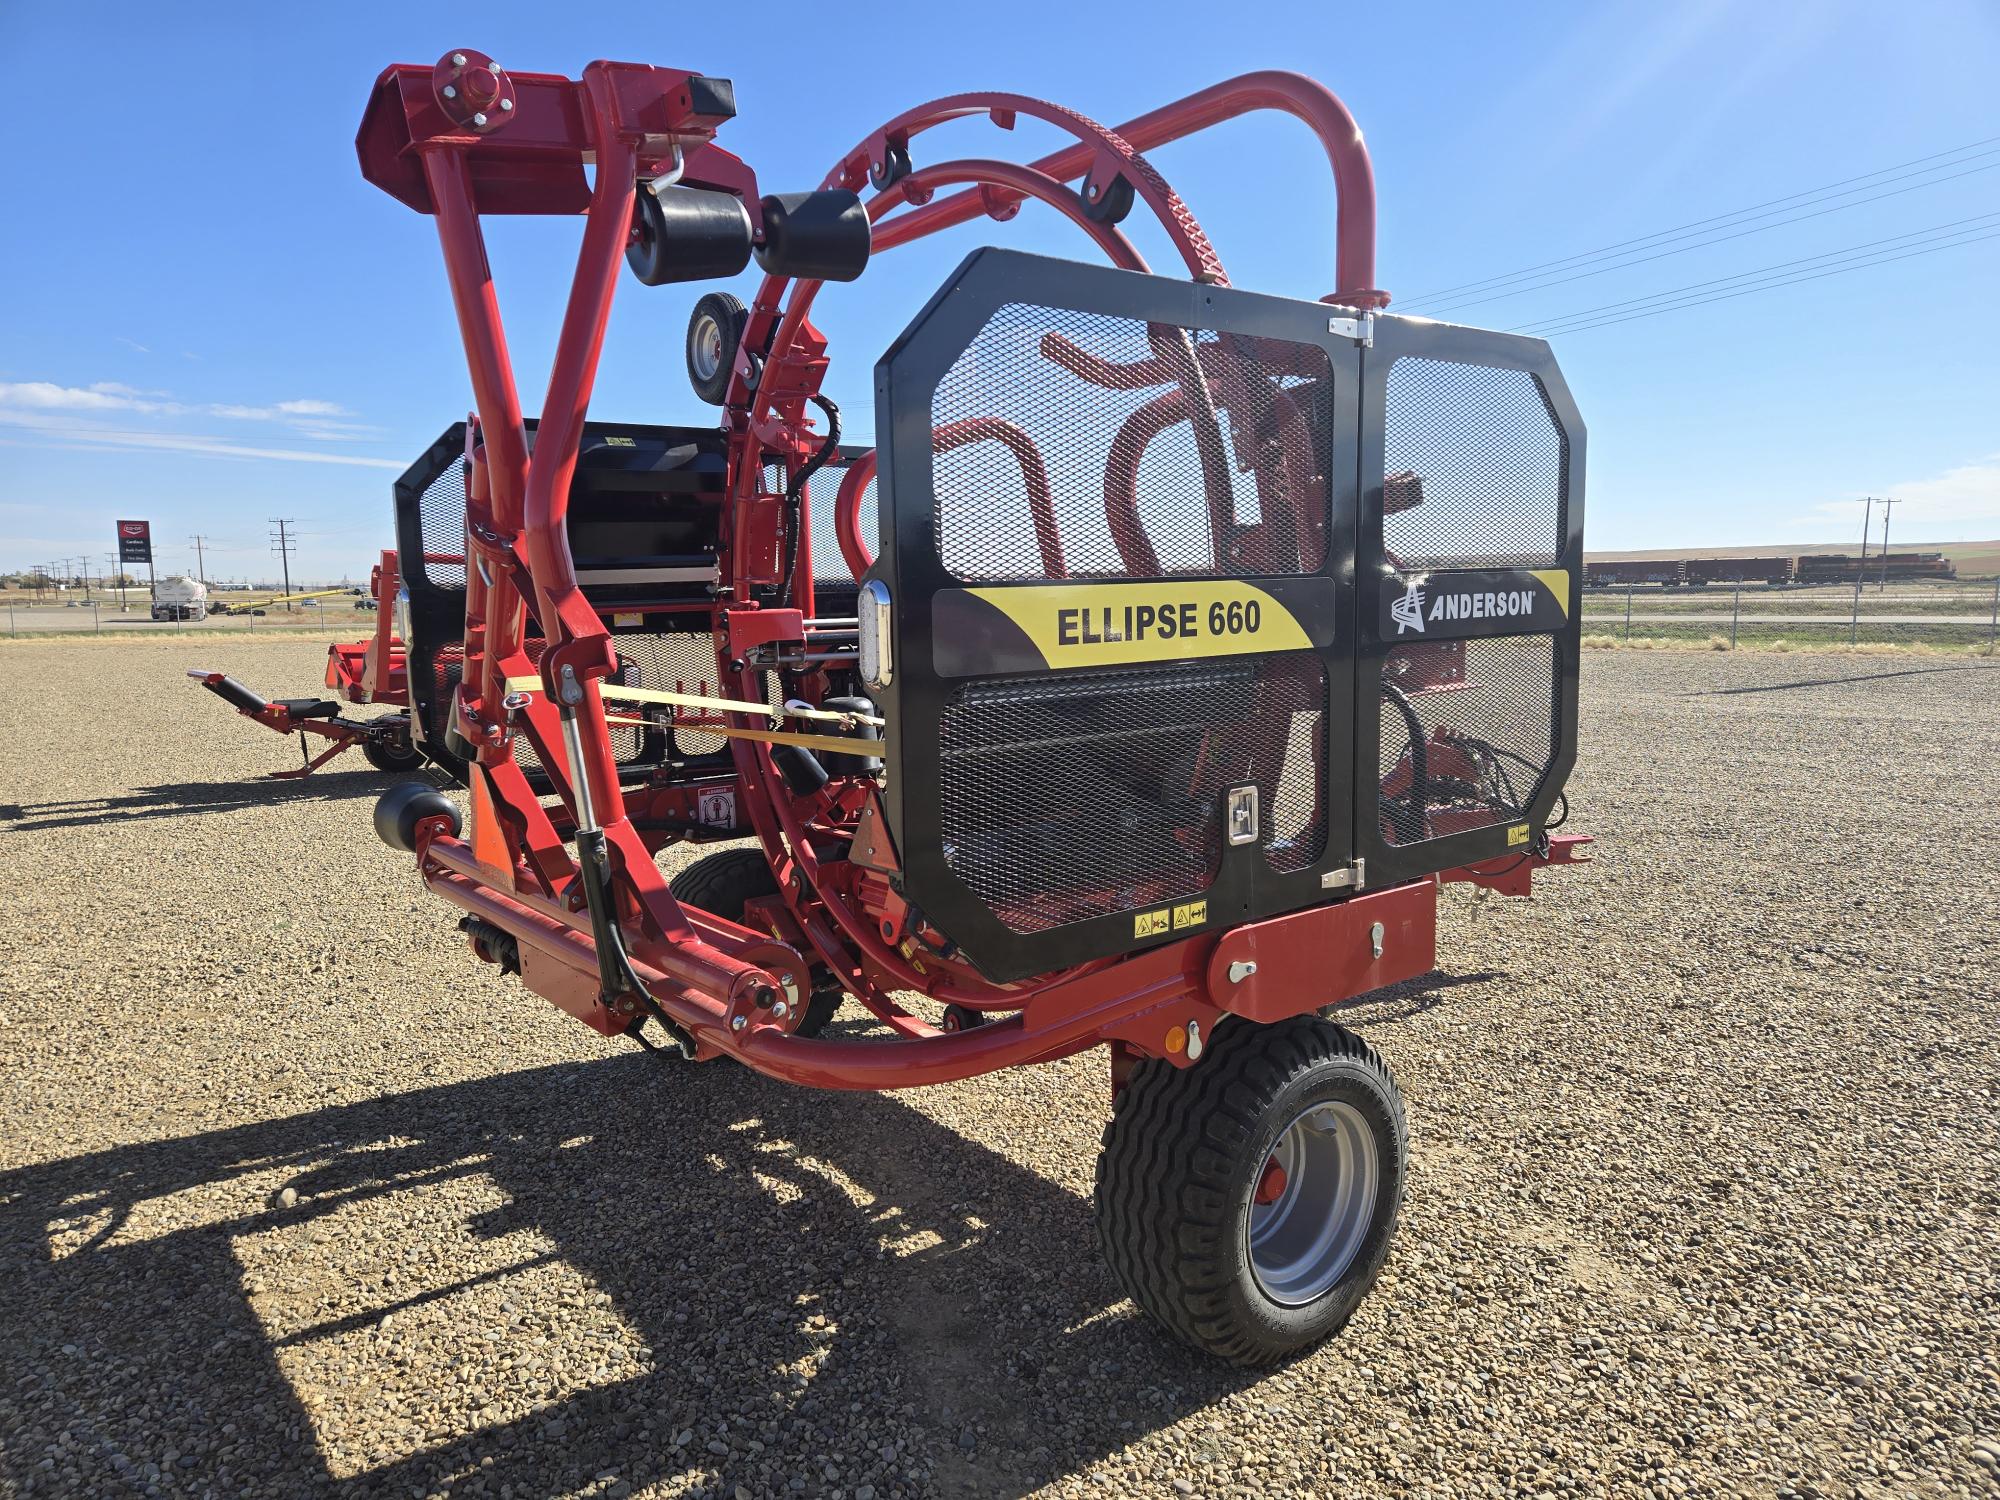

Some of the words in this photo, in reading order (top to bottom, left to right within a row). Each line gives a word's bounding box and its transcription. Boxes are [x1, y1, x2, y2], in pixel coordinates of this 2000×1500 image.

[1058, 603, 1198, 646] ELLIPSE
[1208, 599, 1261, 636] 660
[1428, 591, 1533, 621] ANDERSON
